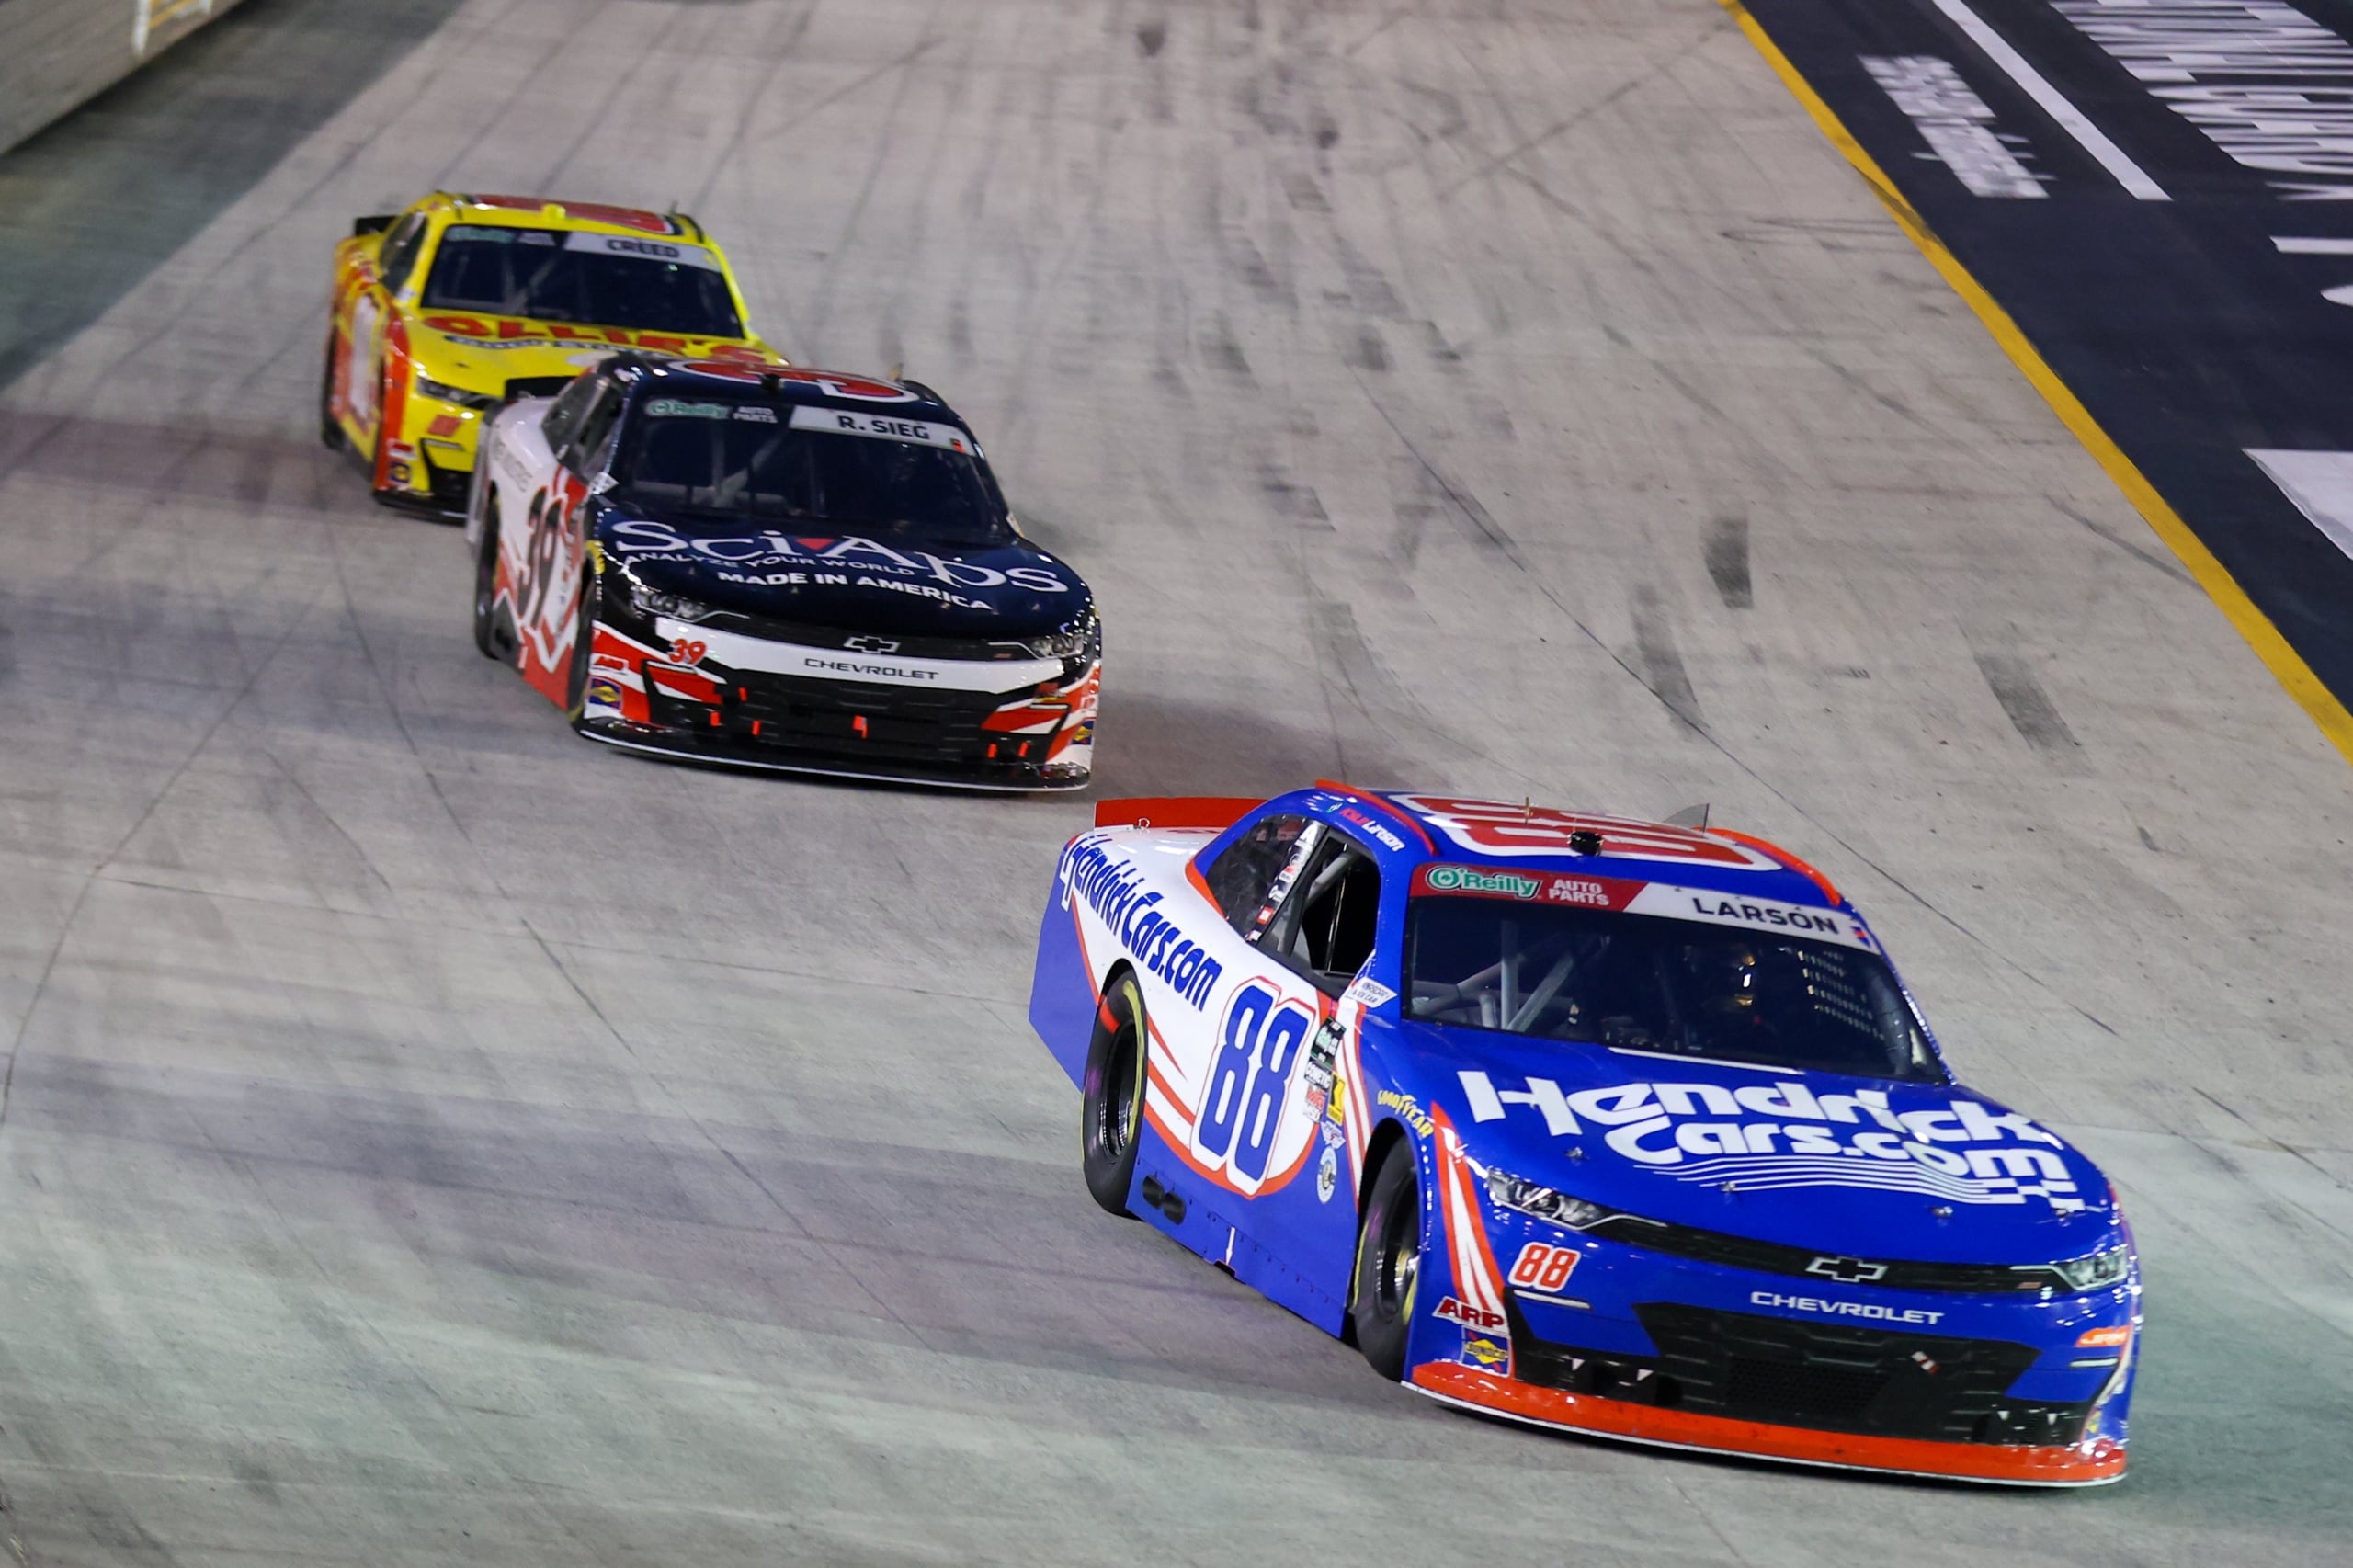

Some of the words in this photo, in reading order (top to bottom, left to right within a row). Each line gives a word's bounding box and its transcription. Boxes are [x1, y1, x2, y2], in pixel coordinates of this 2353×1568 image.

[607, 238, 680, 259] CREED
[423, 315, 768, 363] OLLIE'S
[837, 415, 866, 432] R.
[872, 420, 931, 441] SIEG
[747, 555, 816, 568] YOUR
[821, 559, 915, 576] WORLD
[717, 571, 809, 585] MADE
[815, 574, 848, 585] IN
[856, 576, 994, 610] AMERICA
[669, 638, 707, 665] 39
[803, 656, 939, 681] CHEVROLET
[1427, 867, 1540, 899] O'Reilly
[1548, 887, 1610, 907] PARTS
[1552, 878, 1603, 895] AUTO
[1693, 897, 1839, 936] LARSON
[1198, 982, 1312, 1186] 88
[1376, 1089, 1435, 1138] GOODYEAR
[1457, 1069, 2064, 1150] Hendrick
[1604, 1114, 2072, 1185] Cars.com
[1511, 1243, 1579, 1291] 88
[1437, 1298, 1505, 1328] ARP
[1749, 1290, 1945, 1325] CHEVROLET
